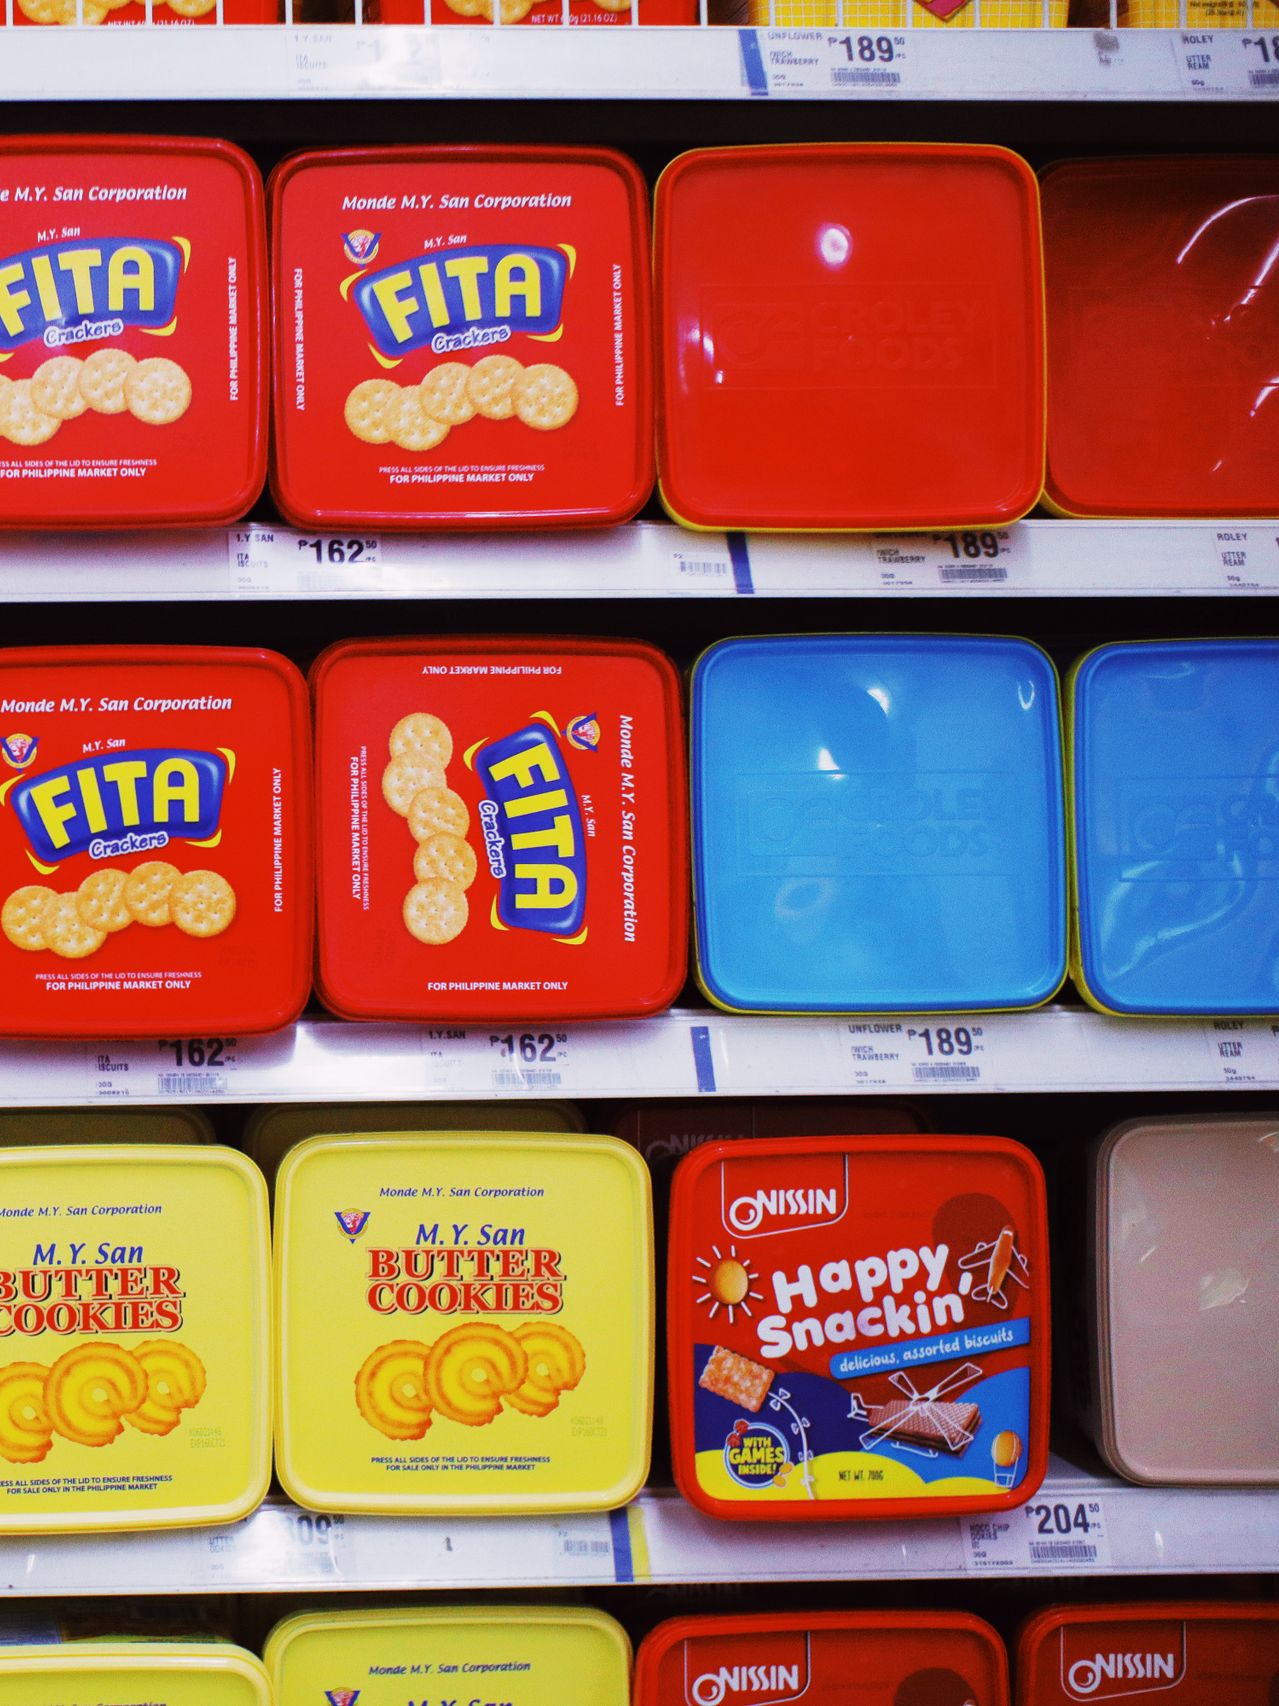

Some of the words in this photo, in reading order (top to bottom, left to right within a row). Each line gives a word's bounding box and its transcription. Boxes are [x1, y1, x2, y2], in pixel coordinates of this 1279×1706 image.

[14, 187, 47, 202] M.Y.
[53, 186, 83, 201] San
[88, 185, 187, 202] Corporation
[372, 253, 541, 343] FITA
[44, 319, 124, 346] Crackers
[431, 326, 511, 353] Crackers
[0, 469, 20, 479] FOR
[22, 468, 75, 478] PHILIPPINE
[77, 468, 118, 478] MARKET
[120, 467, 146, 477] ONLY
[0, 699, 55, 713] Monde
[60, 699, 93, 712] M.Y.
[98, 698, 129, 712] San
[133, 696, 232, 713] Corporation
[106, 738, 126, 749] San
[620, 715, 632, 768] Monde
[621, 772, 635, 805] M.Y.
[31, 757, 200, 849] FITA
[488, 742, 578, 909] FITA
[623, 810, 635, 840] San
[89, 830, 168, 860] Crackers
[478, 800, 507, 878] Crackers
[622, 844, 638, 942] Corporation
[46, 981, 66, 990] FOR
[67, 981, 121, 990] PHILIPPINE
[123, 981, 163, 990] MARKET
[165, 980, 191, 990] ONLY
[428, 982, 448, 991] FOR
[449, 982, 501, 991] PHILIPPINE
[503, 981, 541, 990] MARKET
[544, 981, 568, 990] ONLY
[38, 1206, 62, 1217] M.Y.
[66, 1206, 87, 1216] San
[91, 1204, 162, 1217] Corporation
[33, 1244, 61, 1265] M.
[70, 1243, 87, 1264] Y.
[94, 1242, 143, 1264] San
[367, 1247, 567, 1282] BUTTER
[771, 1244, 949, 1314] Happy
[367, 1281, 564, 1315] COOKIES
[839, 1351, 900, 1374] delicious,
[902, 1336, 960, 1362] assorted
[963, 1328, 1014, 1350] biscuits
[729, 1446, 784, 1464] GAMES
[743, 1437, 771, 1448] WITH
[738, 1463, 777, 1476] INSIDE!
[838, 1471, 852, 1481] NET
[7, 1485, 21, 1494] FOR
[23, 1485, 40, 1493] SALE
[42, 1484, 61, 1493] ONLY
[63, 1484, 70, 1493] IN
[71, 1484, 85, 1493] THE
[87, 1483, 126, 1492] PHILIPPINE
[128, 1483, 157, 1491] MARKET
